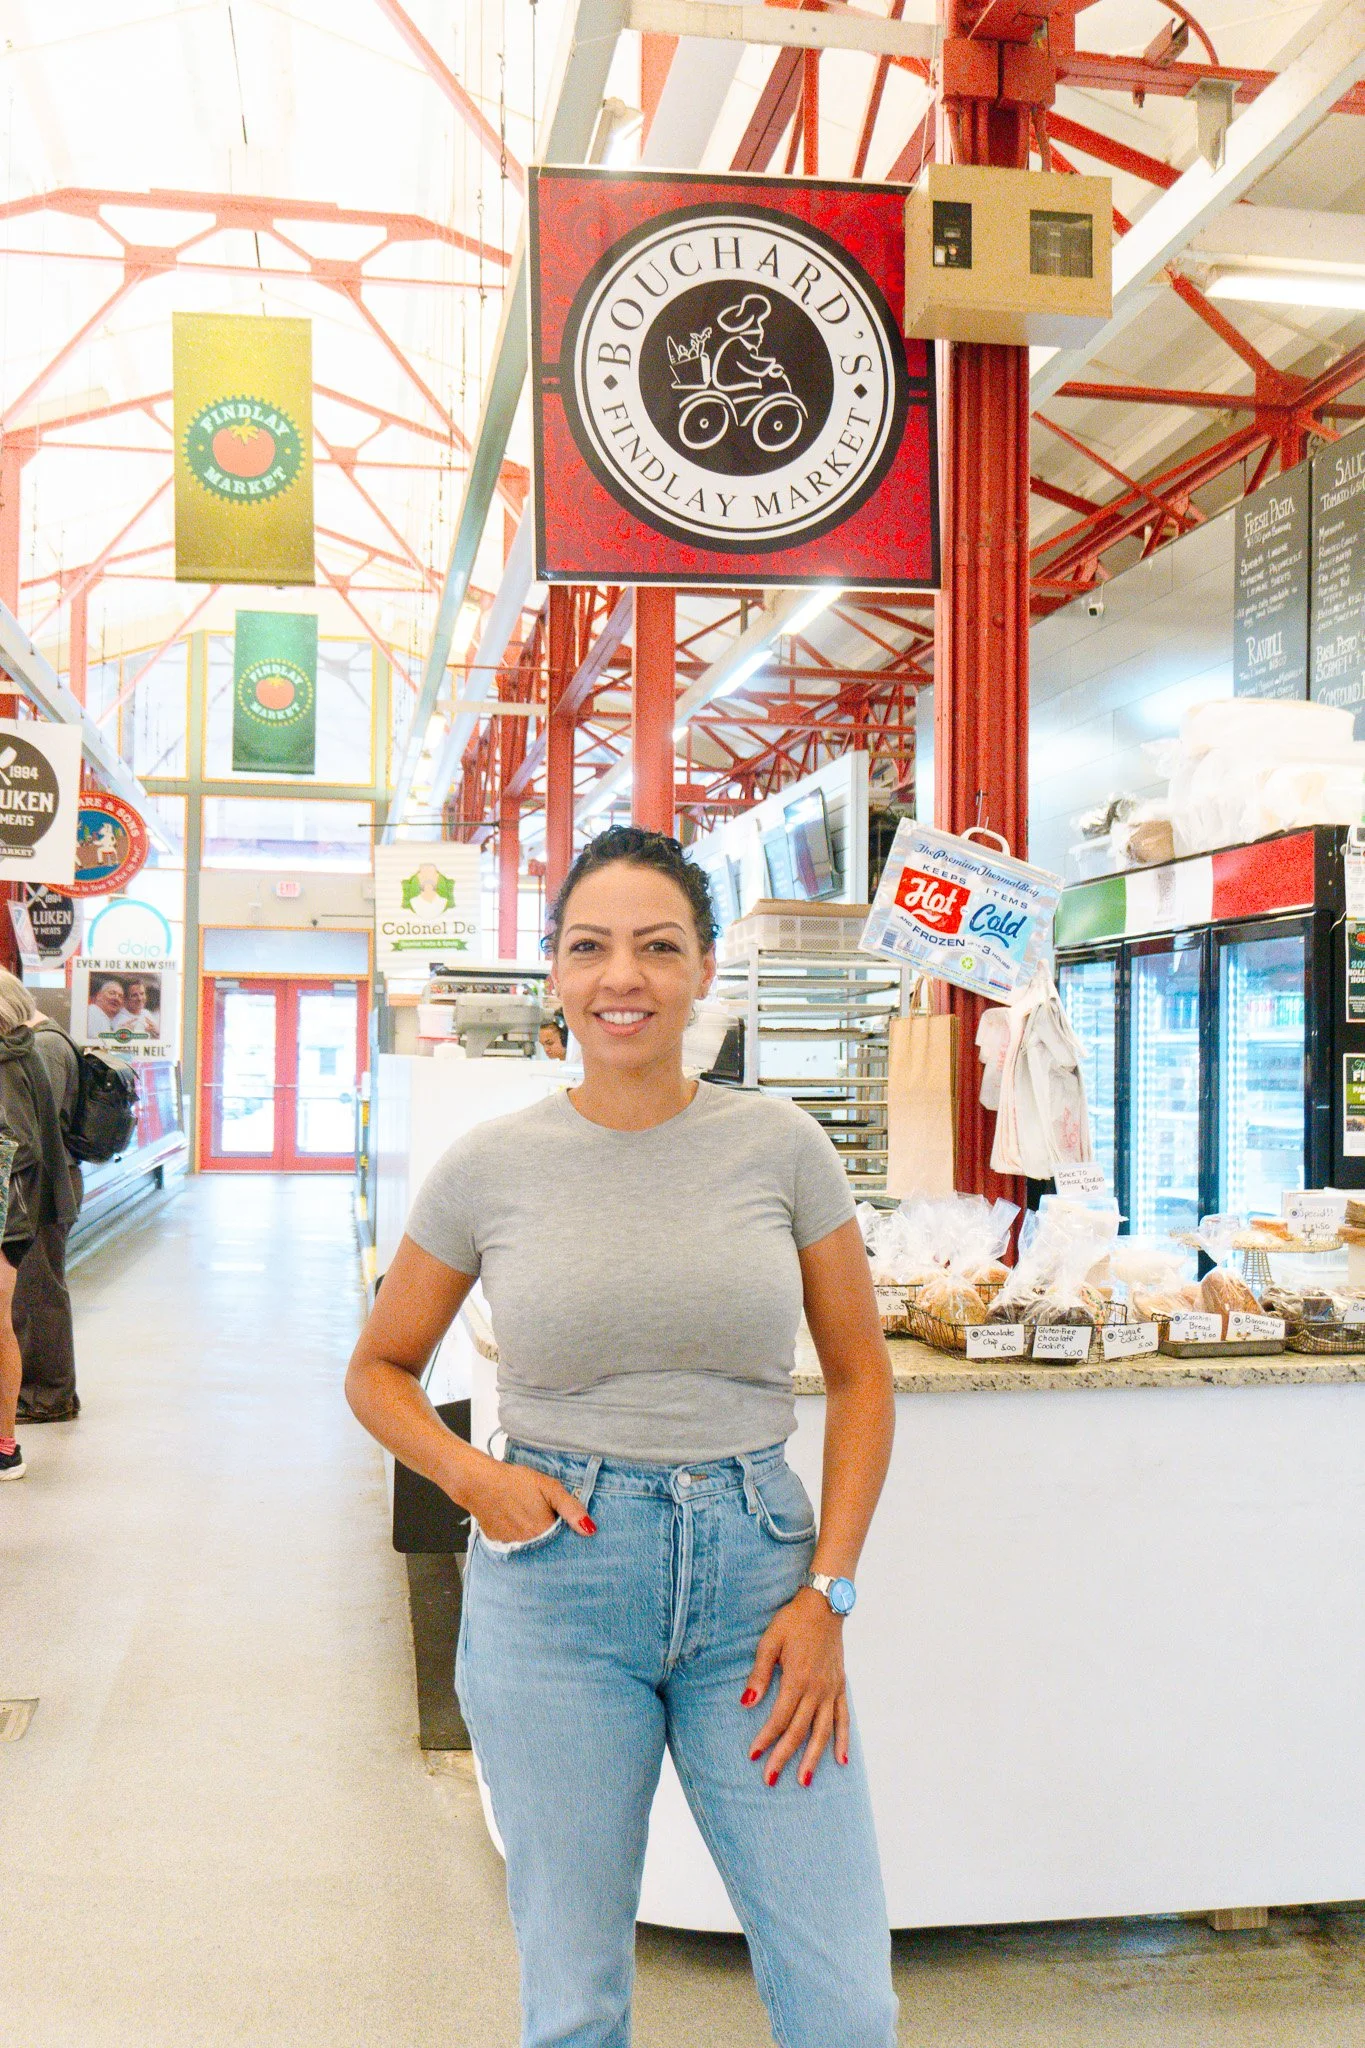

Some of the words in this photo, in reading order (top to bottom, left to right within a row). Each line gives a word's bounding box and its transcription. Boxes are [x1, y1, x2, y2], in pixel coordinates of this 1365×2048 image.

[597, 235, 874, 376] BOUCHARD'S
[200, 403, 291, 436] FINDLAY
[602, 400, 737, 518] FINDLAY
[753, 406, 871, 519] MARKET
[204, 466, 286, 495] MARKET
[1244, 510, 1269, 538] FRESH
[1269, 496, 1295, 524] PASTA
[1246, 631, 1282, 666] RAVIOLI
[249, 664, 303, 684] FINDLAY
[250, 701, 300, 719] MARKET
[0, 814, 35, 827] MEATS
[116, 808, 140, 837] SONS
[922, 864, 967, 885] KEEPS
[904, 876, 957, 915] Hot
[985, 888, 1029, 909] ITEMS
[33, 911, 72, 925] LUKEN
[382, 921, 447, 936] Colonel
[453, 921, 476, 934] De
[969, 903, 1027, 939] Cold
[118, 938, 161, 959] dojo
[911, 925, 966, 947] FROZEN
[981, 945, 991, 955] 3
[76, 959, 101, 969] EVEN
[105, 960, 122, 970] JOE
[981, 1329, 1015, 1337] Chocolate
[1189, 1322, 1211, 1331] Bread
[1253, 1325, 1275, 1335] Bread
[983, 1338, 998, 1349] Chip
